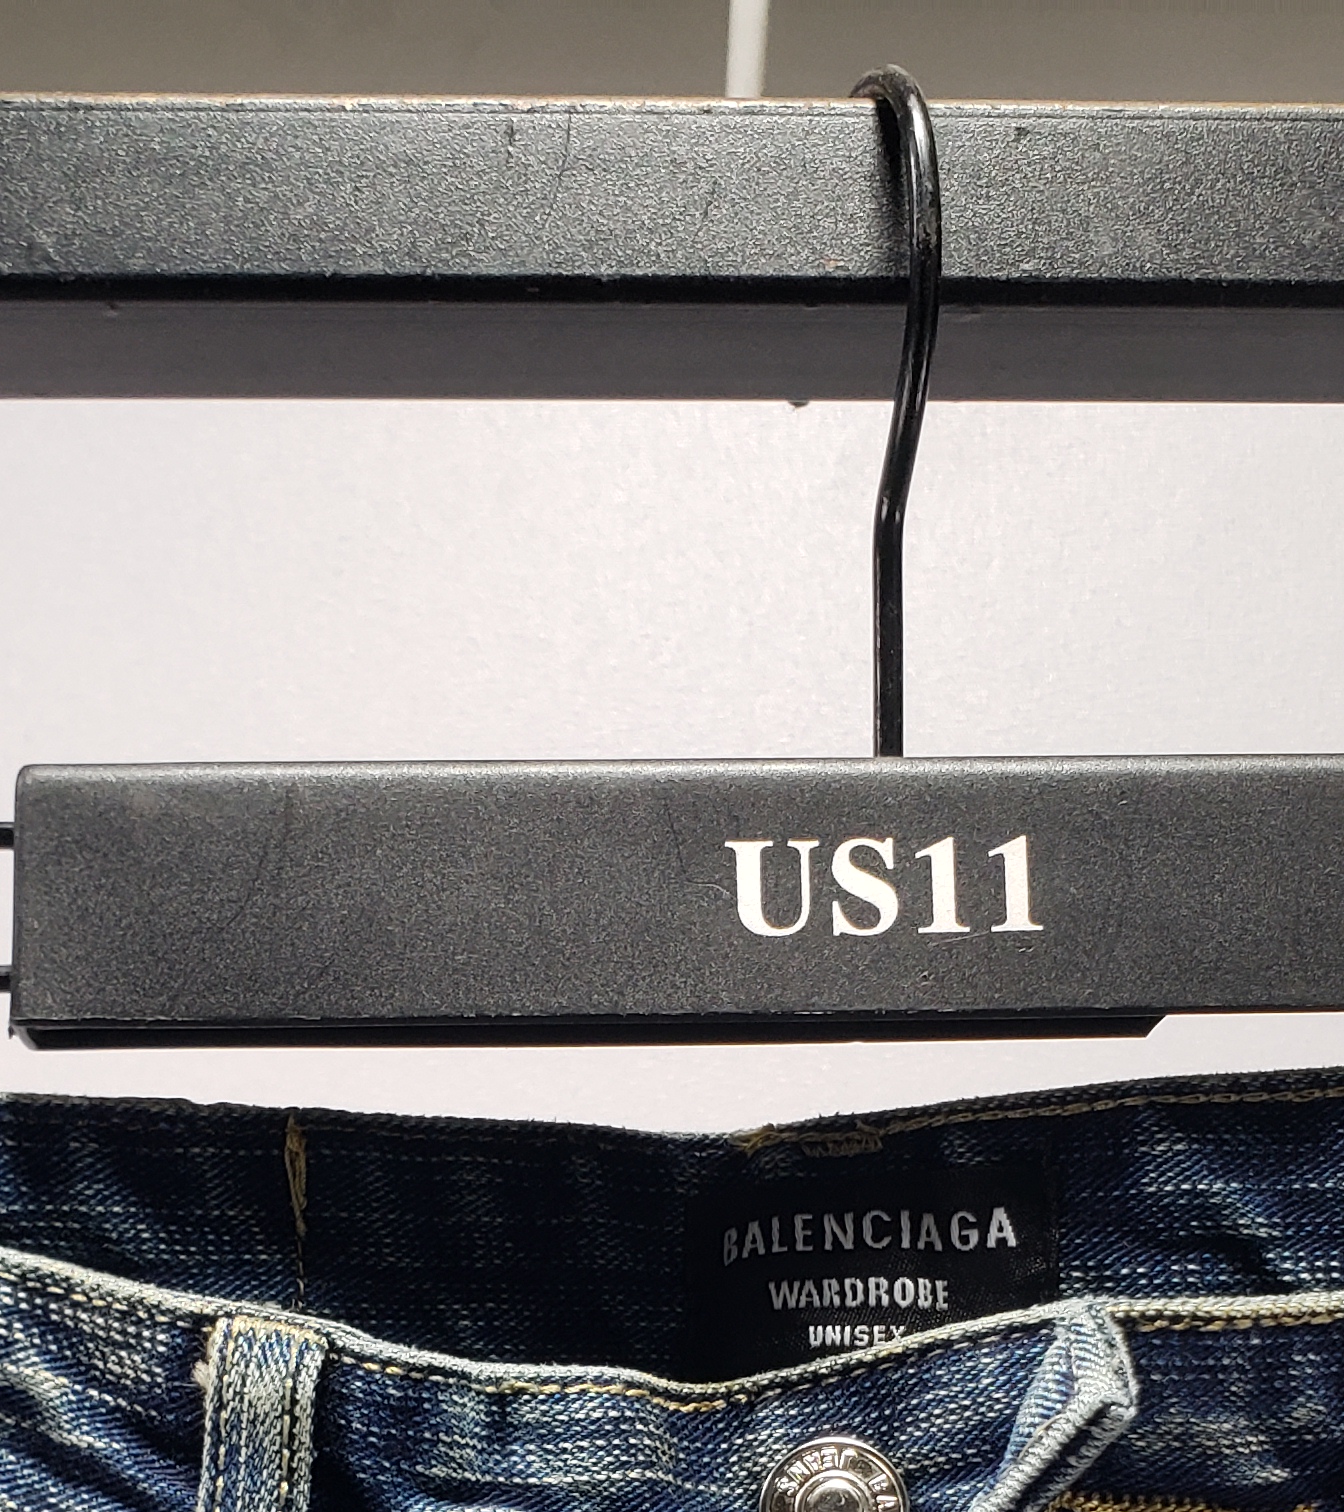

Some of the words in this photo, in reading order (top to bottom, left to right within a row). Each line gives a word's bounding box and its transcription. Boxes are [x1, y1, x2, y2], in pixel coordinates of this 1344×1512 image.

[724, 834, 1044, 936] US11
[723, 1207, 1017, 1267] BALENCIAGA
[768, 1276, 949, 1310] WARDROBE
[808, 1325, 905, 1348] UNISEX
